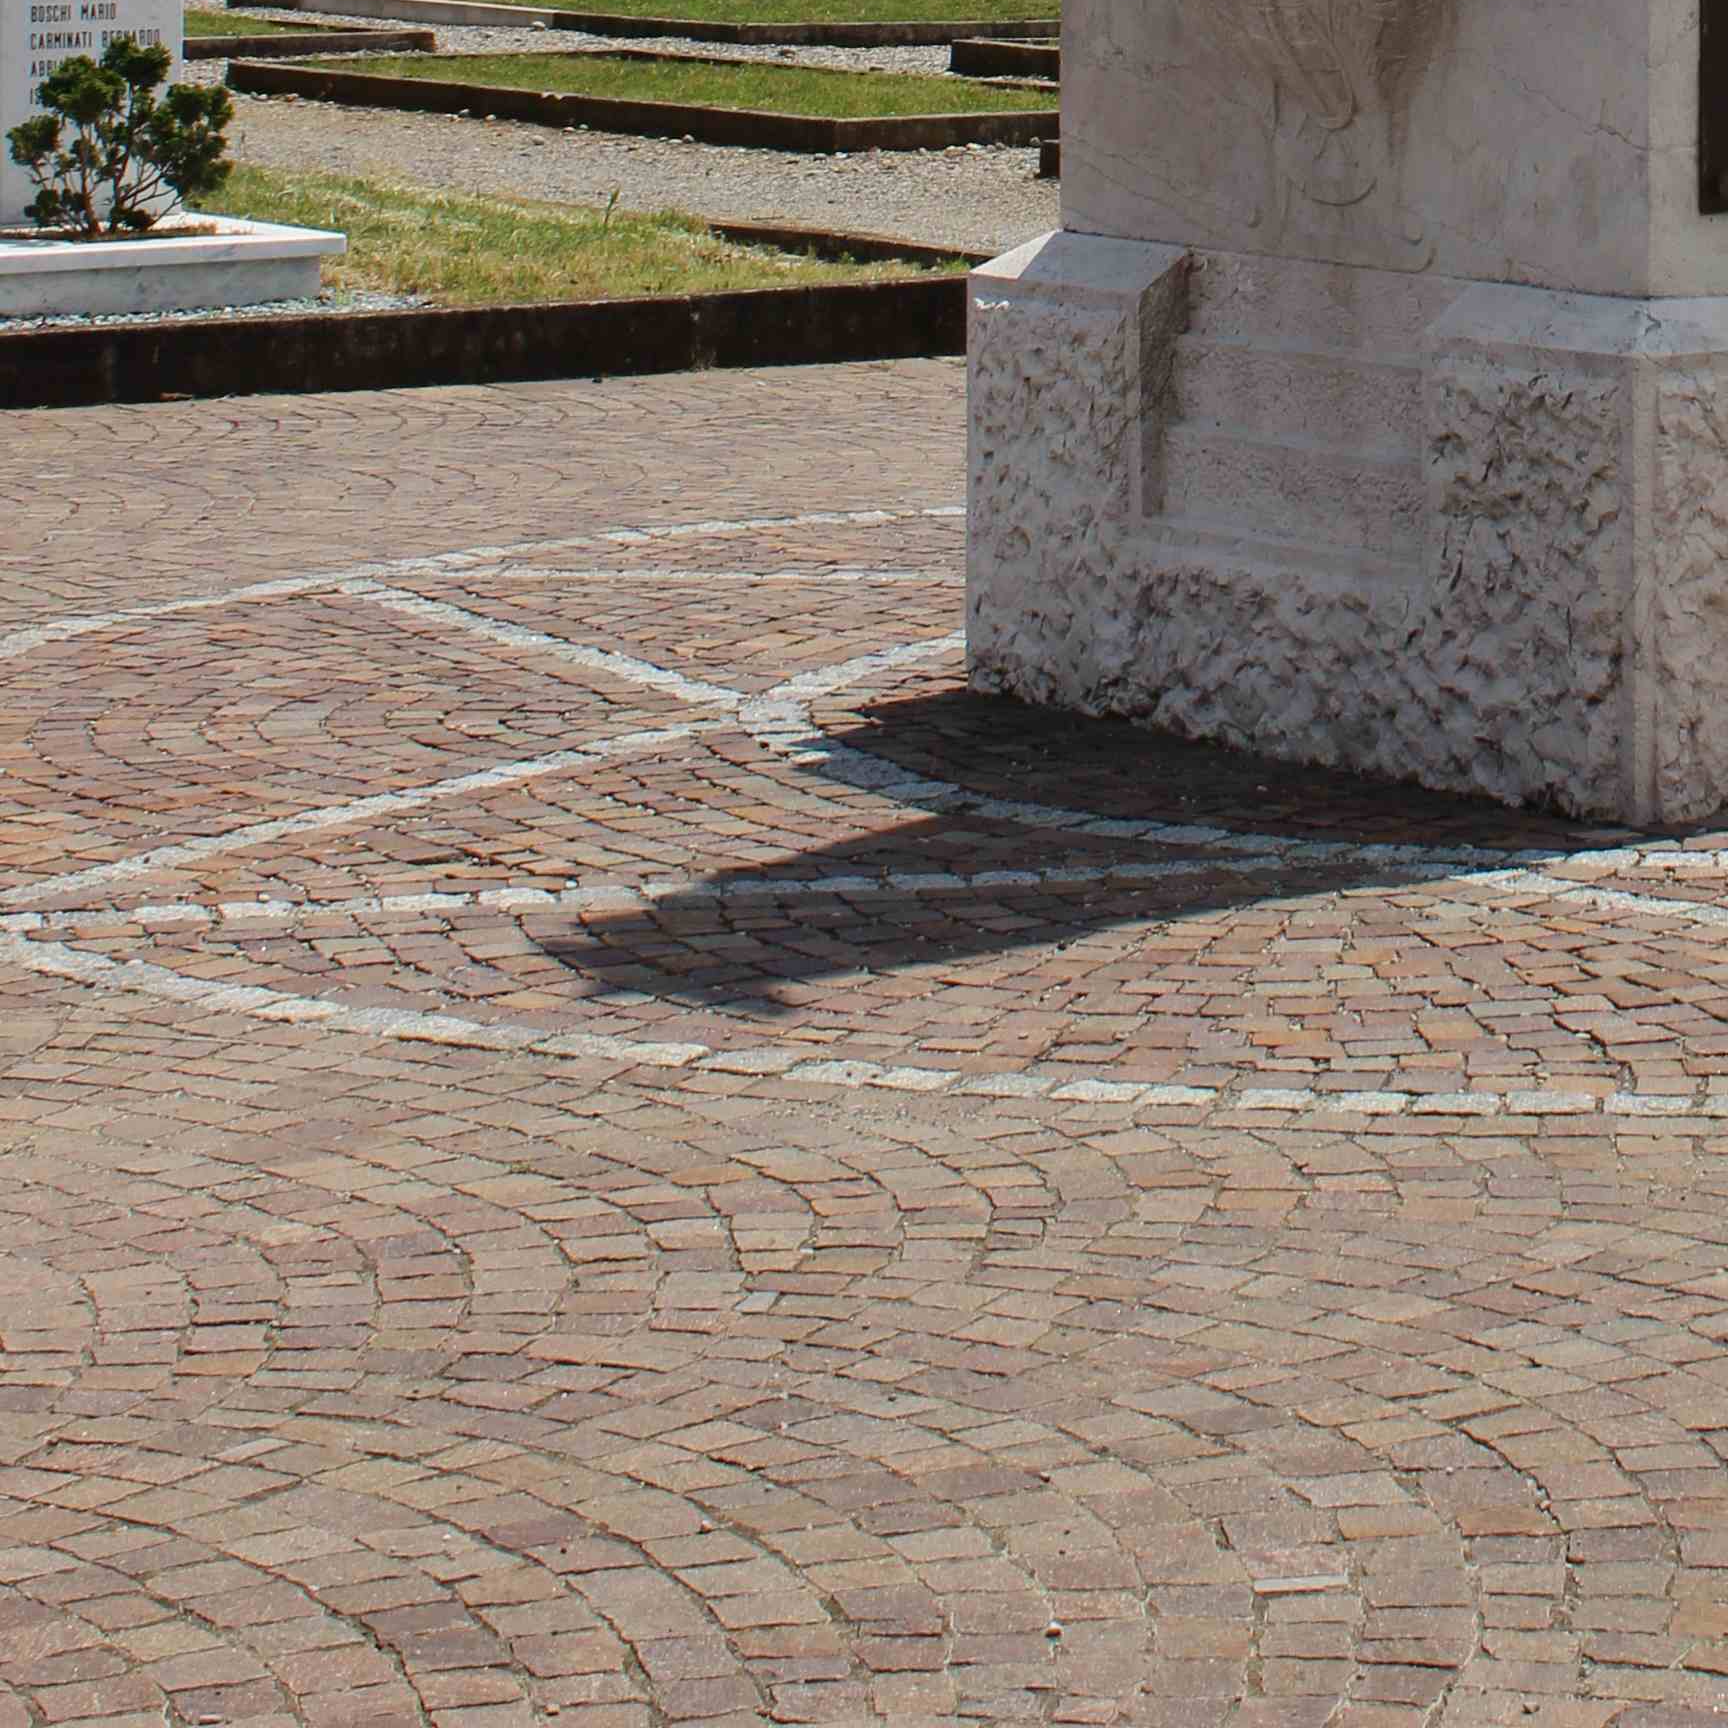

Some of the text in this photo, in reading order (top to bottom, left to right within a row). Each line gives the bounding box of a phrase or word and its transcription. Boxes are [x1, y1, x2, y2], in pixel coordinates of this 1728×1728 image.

[31, 3, 117, 23] BOSCHI MARIO
[30, 32, 92, 50] CARMINATI
